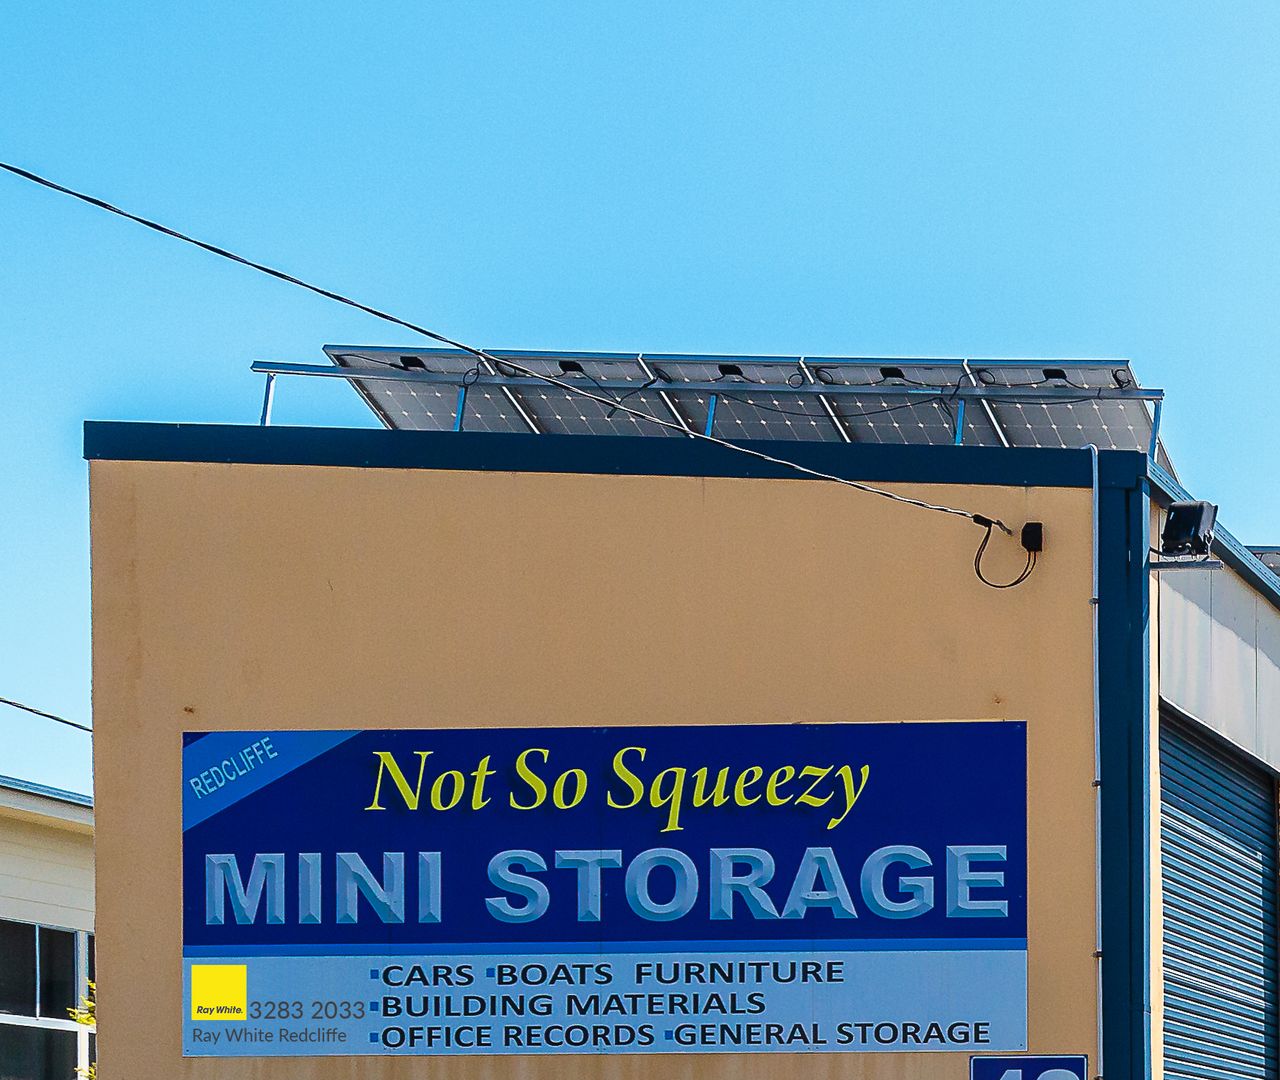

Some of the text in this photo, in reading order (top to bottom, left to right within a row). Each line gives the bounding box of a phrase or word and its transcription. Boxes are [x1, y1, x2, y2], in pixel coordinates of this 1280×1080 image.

[190, 736, 278, 799] REDCLIFFE
[365, 746, 870, 833] Not So Squeezy
[205, 845, 1009, 925] MINI STORAGE
[382, 961, 844, 986] CARS BOATS FURNITURE
[382, 992, 766, 1017] BUILDING MATERIALS
[381, 1021, 991, 1048] OFFICE RECORDS GENERAL STORAGE
